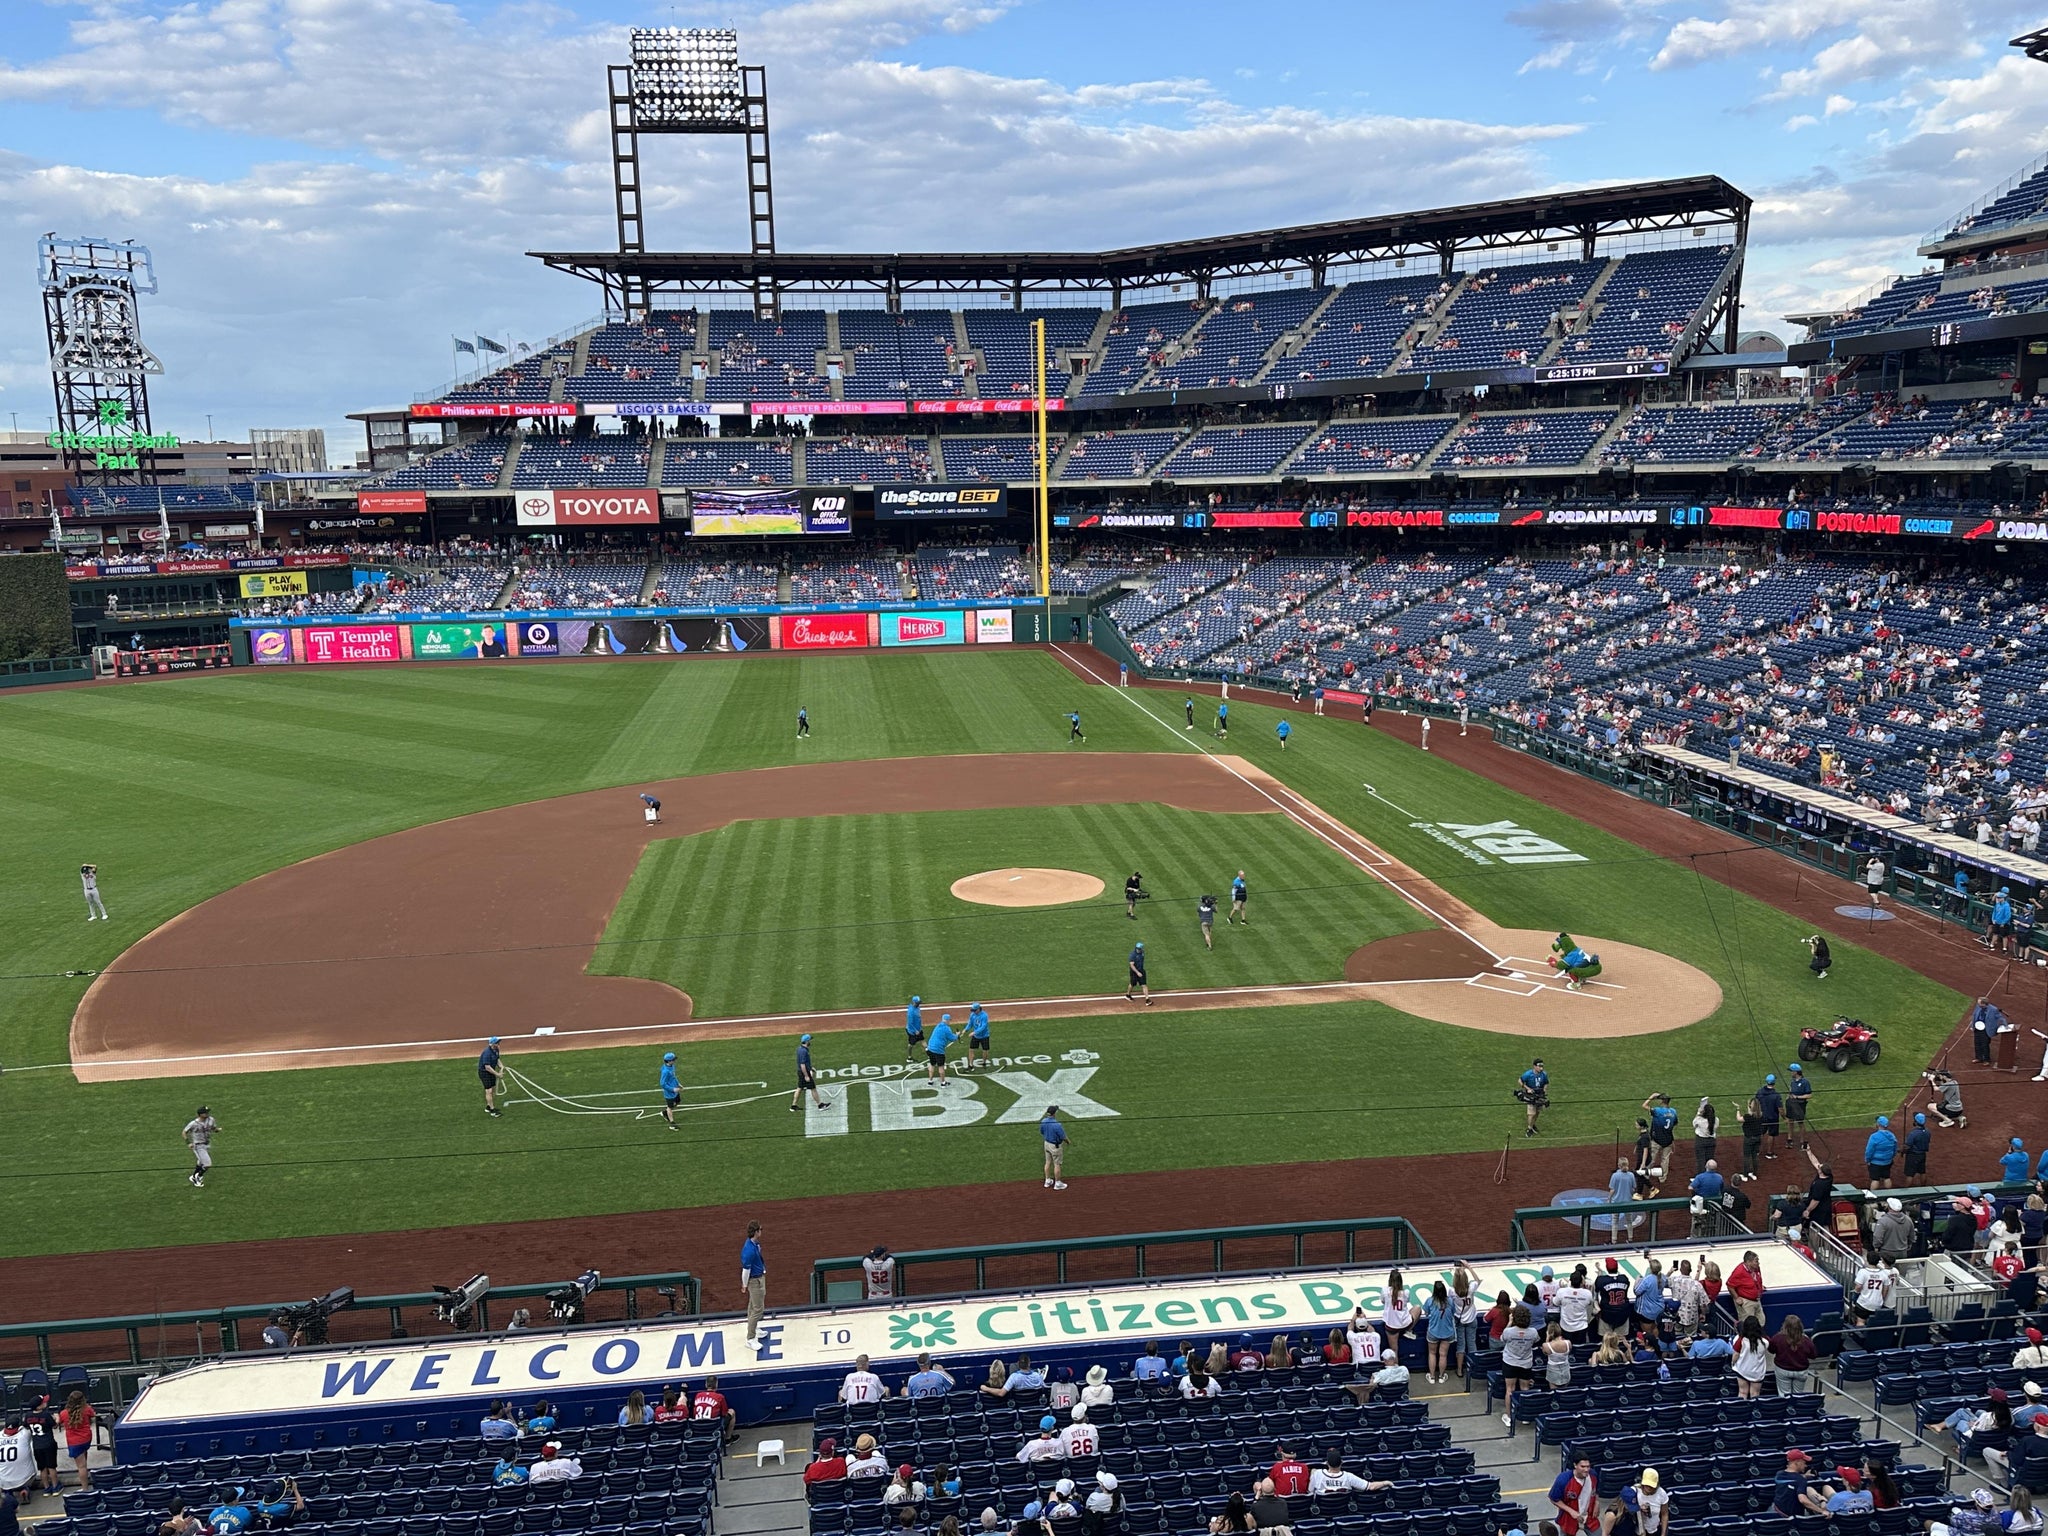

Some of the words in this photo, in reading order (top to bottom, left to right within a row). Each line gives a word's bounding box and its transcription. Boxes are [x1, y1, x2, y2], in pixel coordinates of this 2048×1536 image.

[1547, 370, 1580, 379] 6:25:13
[1582, 368, 1596, 376] PM
[441, 406, 475, 415] Phillies
[477, 407, 494, 415] win
[515, 405, 543, 415] Deals
[545, 405, 558, 414] roll
[560, 404, 569, 414] in
[617, 405, 664, 414] LISCIO'S
[668, 405, 712, 413] BAKERY
[756, 405, 784, 413] WHEY
[786, 405, 818, 413] BETTER
[820, 404, 862, 412] PROTEIN
[49, 431, 129, 449] Citizens
[131, 431, 180, 449] Bank
[95, 451, 140, 469] Park
[881, 490, 957, 504] theScore
[962, 491, 996, 501] BET
[560, 498, 651, 516] TOYOTA
[812, 497, 846, 511] KDI
[812, 517, 847, 525] TECHNOLOGY
[1101, 514, 1143, 526] JORDAN
[1144, 514, 1175, 526] DAVIS
[1347, 511, 1443, 526] POSTGAME
[1448, 512, 1499, 523] CONCERT
[1547, 511, 1609, 523] JORDAN
[1611, 510, 1657, 523] DAVIS
[1817, 512, 1900, 534] POSTGAME
[1905, 519, 1953, 533] CONCERT
[1997, 521, 2048, 541] JORDA
[181, 563, 220, 571] Budweiser
[305, 557, 340, 565] Budweiser
[269, 576, 291, 585] PLAY
[281, 584, 302, 593] WIN!
[903, 622, 939, 635] HERR'S
[981, 617, 1008, 627] WM
[339, 630, 393, 646] Temple
[793, 624, 857, 644] Chick-fil-A
[342, 646, 392, 659] Health
[170, 661, 196, 670] TOYOTA
[1436, 820, 1590, 864] IBX
[804, 1067, 1121, 1137] IBX
[1664, 1118, 1670, 1129] 3
[2006, 1265, 2014, 1276] 3
[871, 1271, 888, 1284] 52
[1868, 1279, 1882, 1290] 27
[1609, 1290, 1625, 1305] 12
[322, 1325, 784, 1398] WELCOME
[820, 1329, 851, 1345] TO
[976, 1289, 1288, 1341] Citizens
[1361, 1344, 1374, 1358] 10
[855, 1385, 867, 1400] 17
[1057, 1395, 1070, 1408] 15
[695, 1406, 712, 1420] 34
[30, 1424, 43, 1436] 13
[1071, 1430, 1089, 1438] UTLEY
[1071, 1438, 1093, 1456] 26
[0, 1446, 17, 1463] 10
[540, 1468, 561, 1478] HARPER
[1282, 1466, 1302, 1474] ALBIES
[1290, 1476, 1298, 1493] 1
